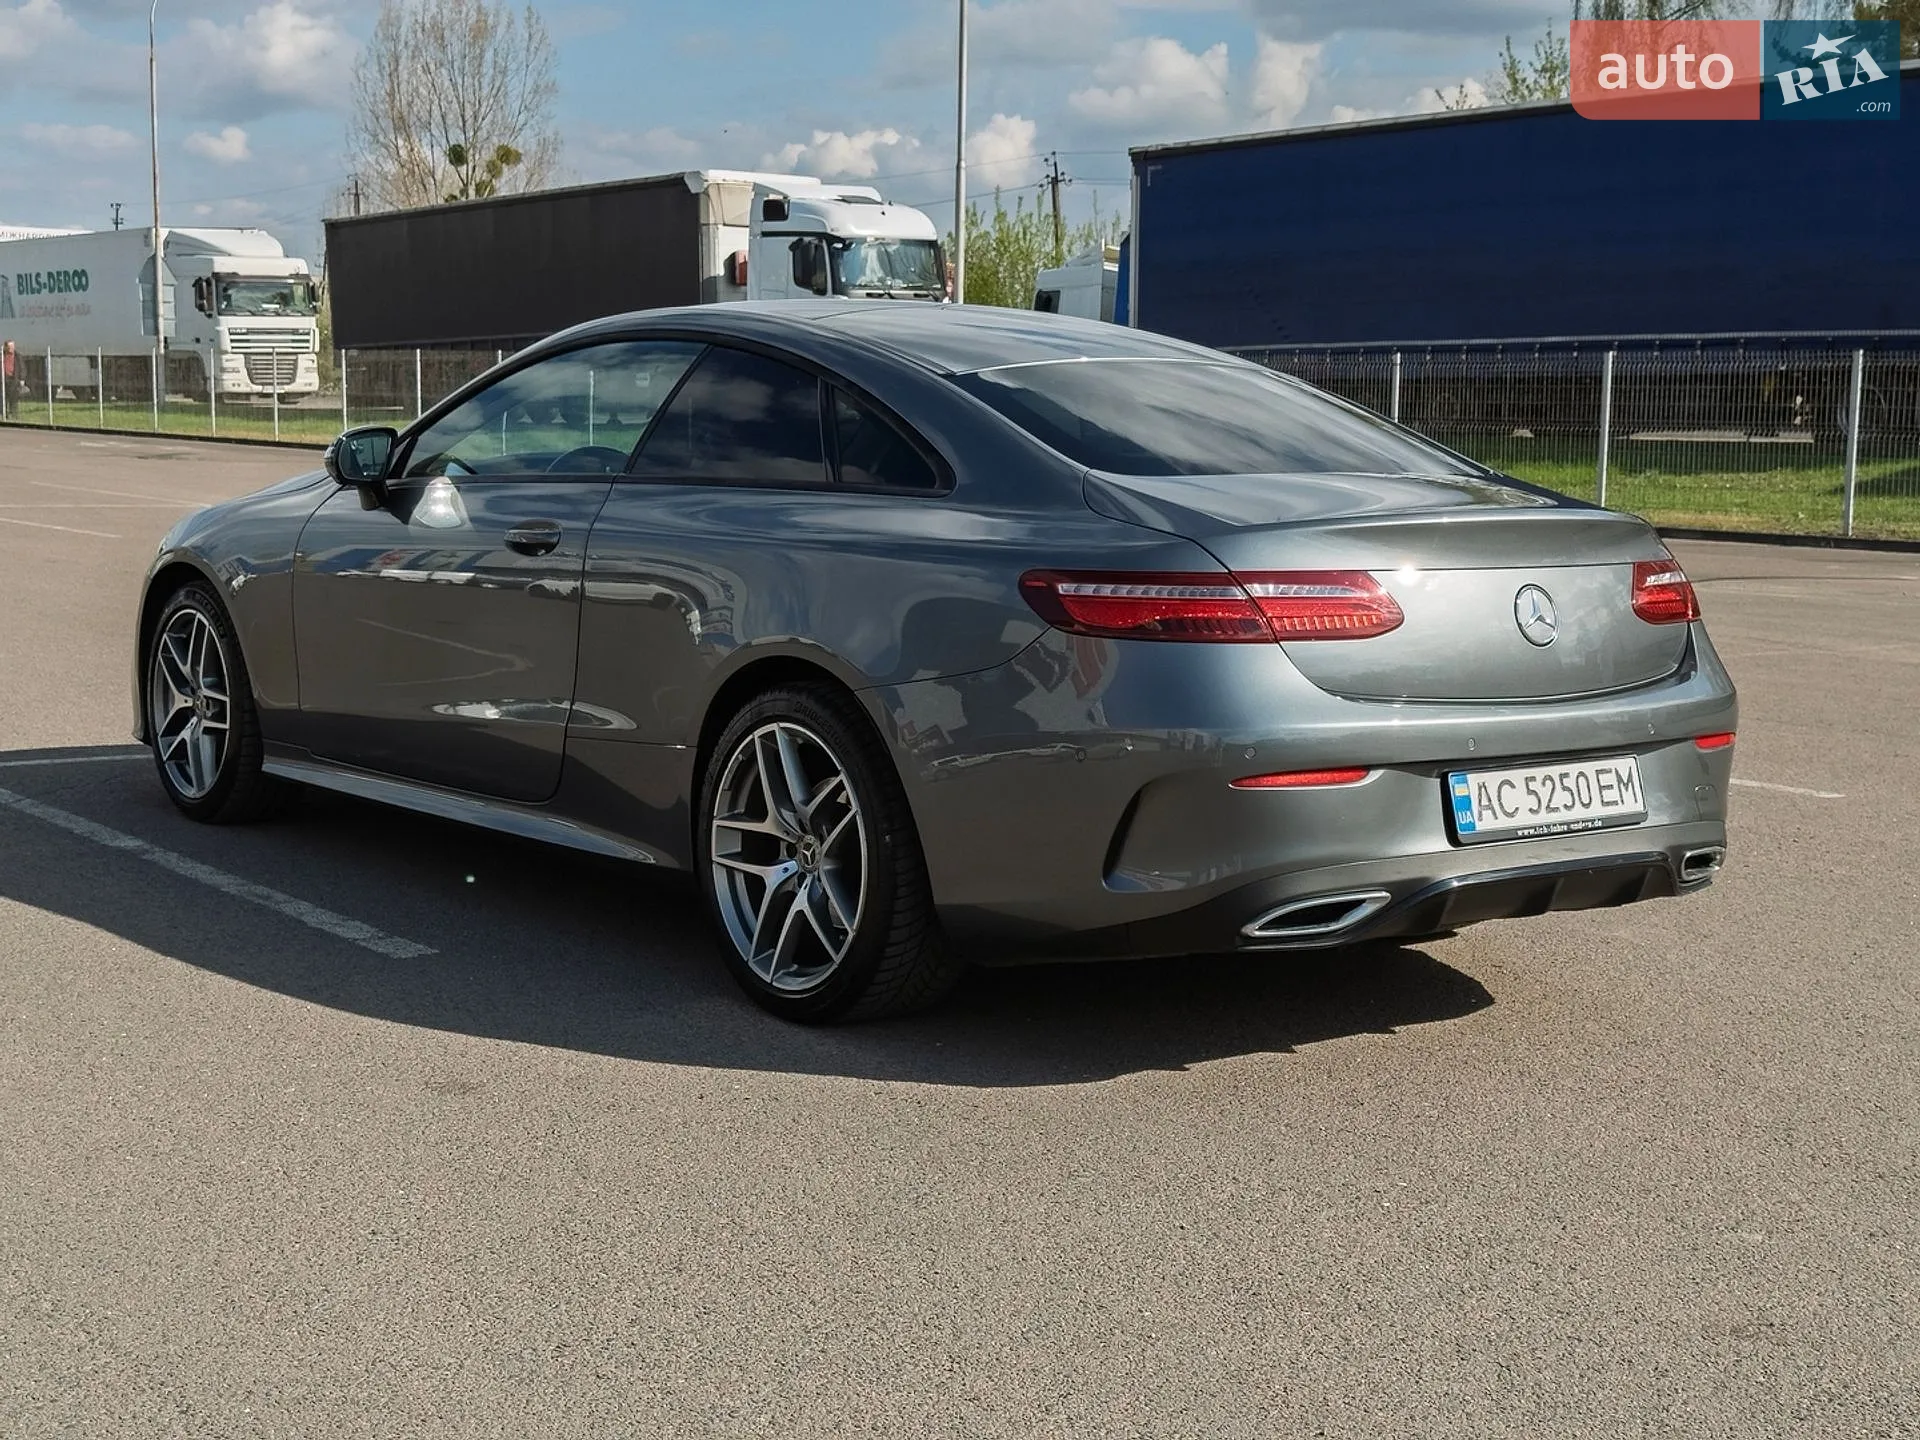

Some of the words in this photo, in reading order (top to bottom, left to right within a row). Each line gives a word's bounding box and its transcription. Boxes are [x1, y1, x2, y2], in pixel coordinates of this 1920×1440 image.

[16, 268, 90, 296] BILS-DEROO
[1476, 778, 1520, 822] AC
[1523, 769, 1593, 816] 5250
[1595, 766, 1639, 808] EM
[1458, 810, 1475, 824] UA
